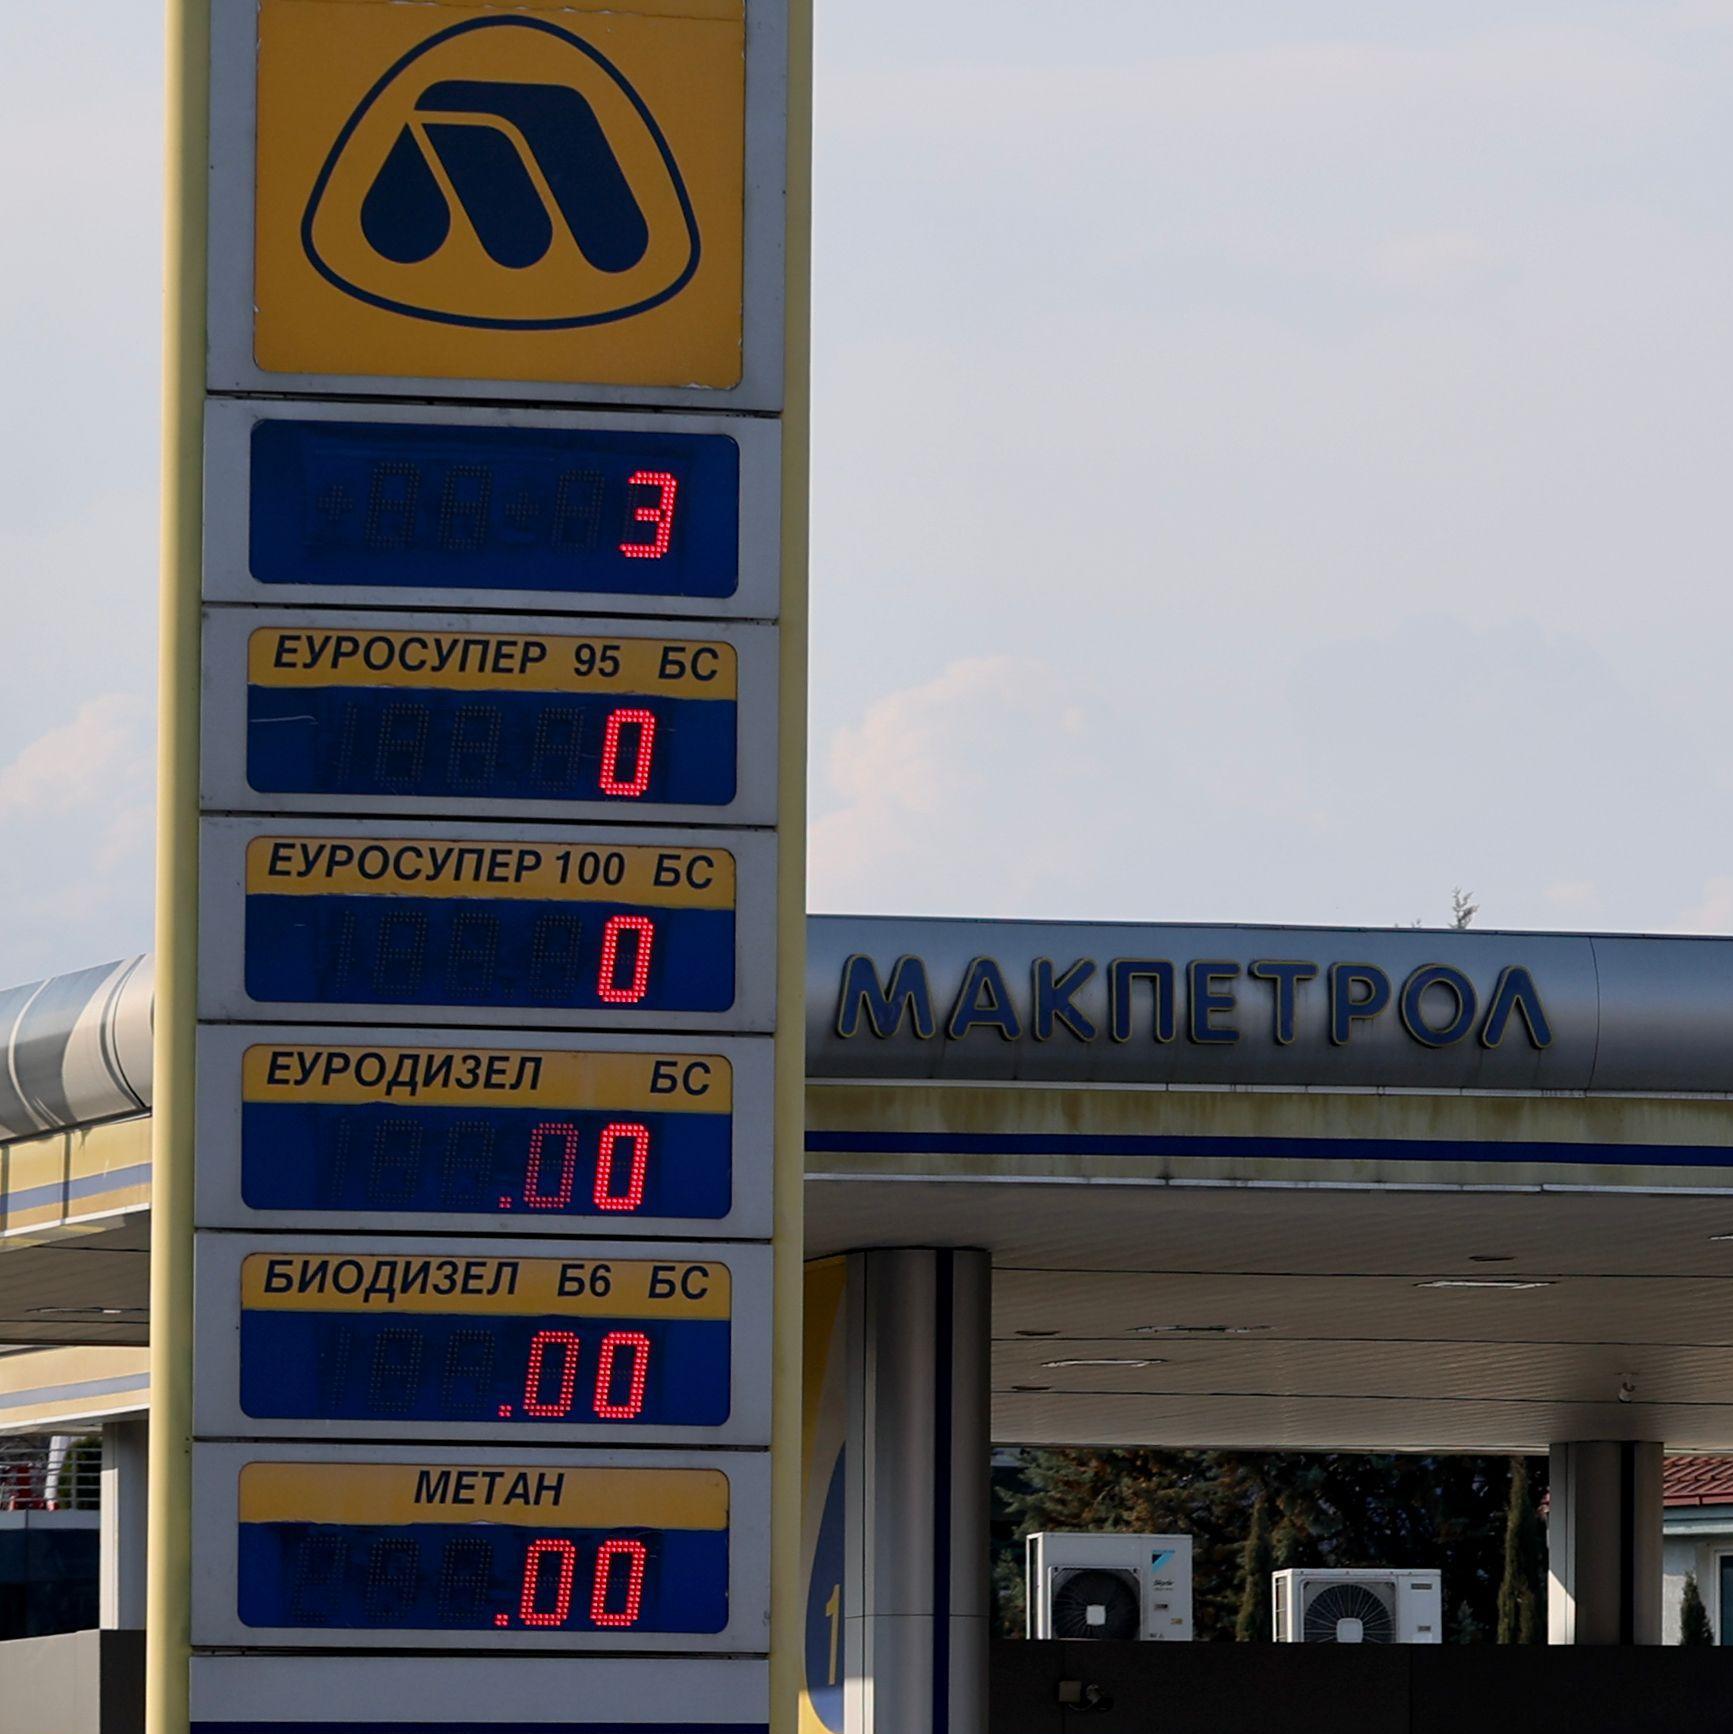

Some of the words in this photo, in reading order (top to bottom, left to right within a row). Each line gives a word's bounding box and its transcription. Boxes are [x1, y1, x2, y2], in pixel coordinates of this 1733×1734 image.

[619, 471, 677, 559] 3
[273, 634, 547, 677] ЕУРОСУПЕР
[574, 643, 621, 679] 95
[658, 646, 720, 682] БС
[599, 708, 656, 797] 0
[267, 842, 543, 885] ЕУРОСУПЕР
[555, 850, 625, 886] 100
[652, 854, 715, 890] БС
[598, 915, 654, 1003] 0
[837, 953, 1553, 1049] МАКПЕТРОЛ
[266, 1050, 543, 1096] ЕУРОДИЗЕЛ
[649, 1060, 712, 1096] БС
[263, 1258, 519, 1303] БИОДИЗЕЛ
[557, 1263, 612, 1298] Б6
[647, 1265, 710, 1300] БС
[414, 1469, 565, 1507] МЕТАН
